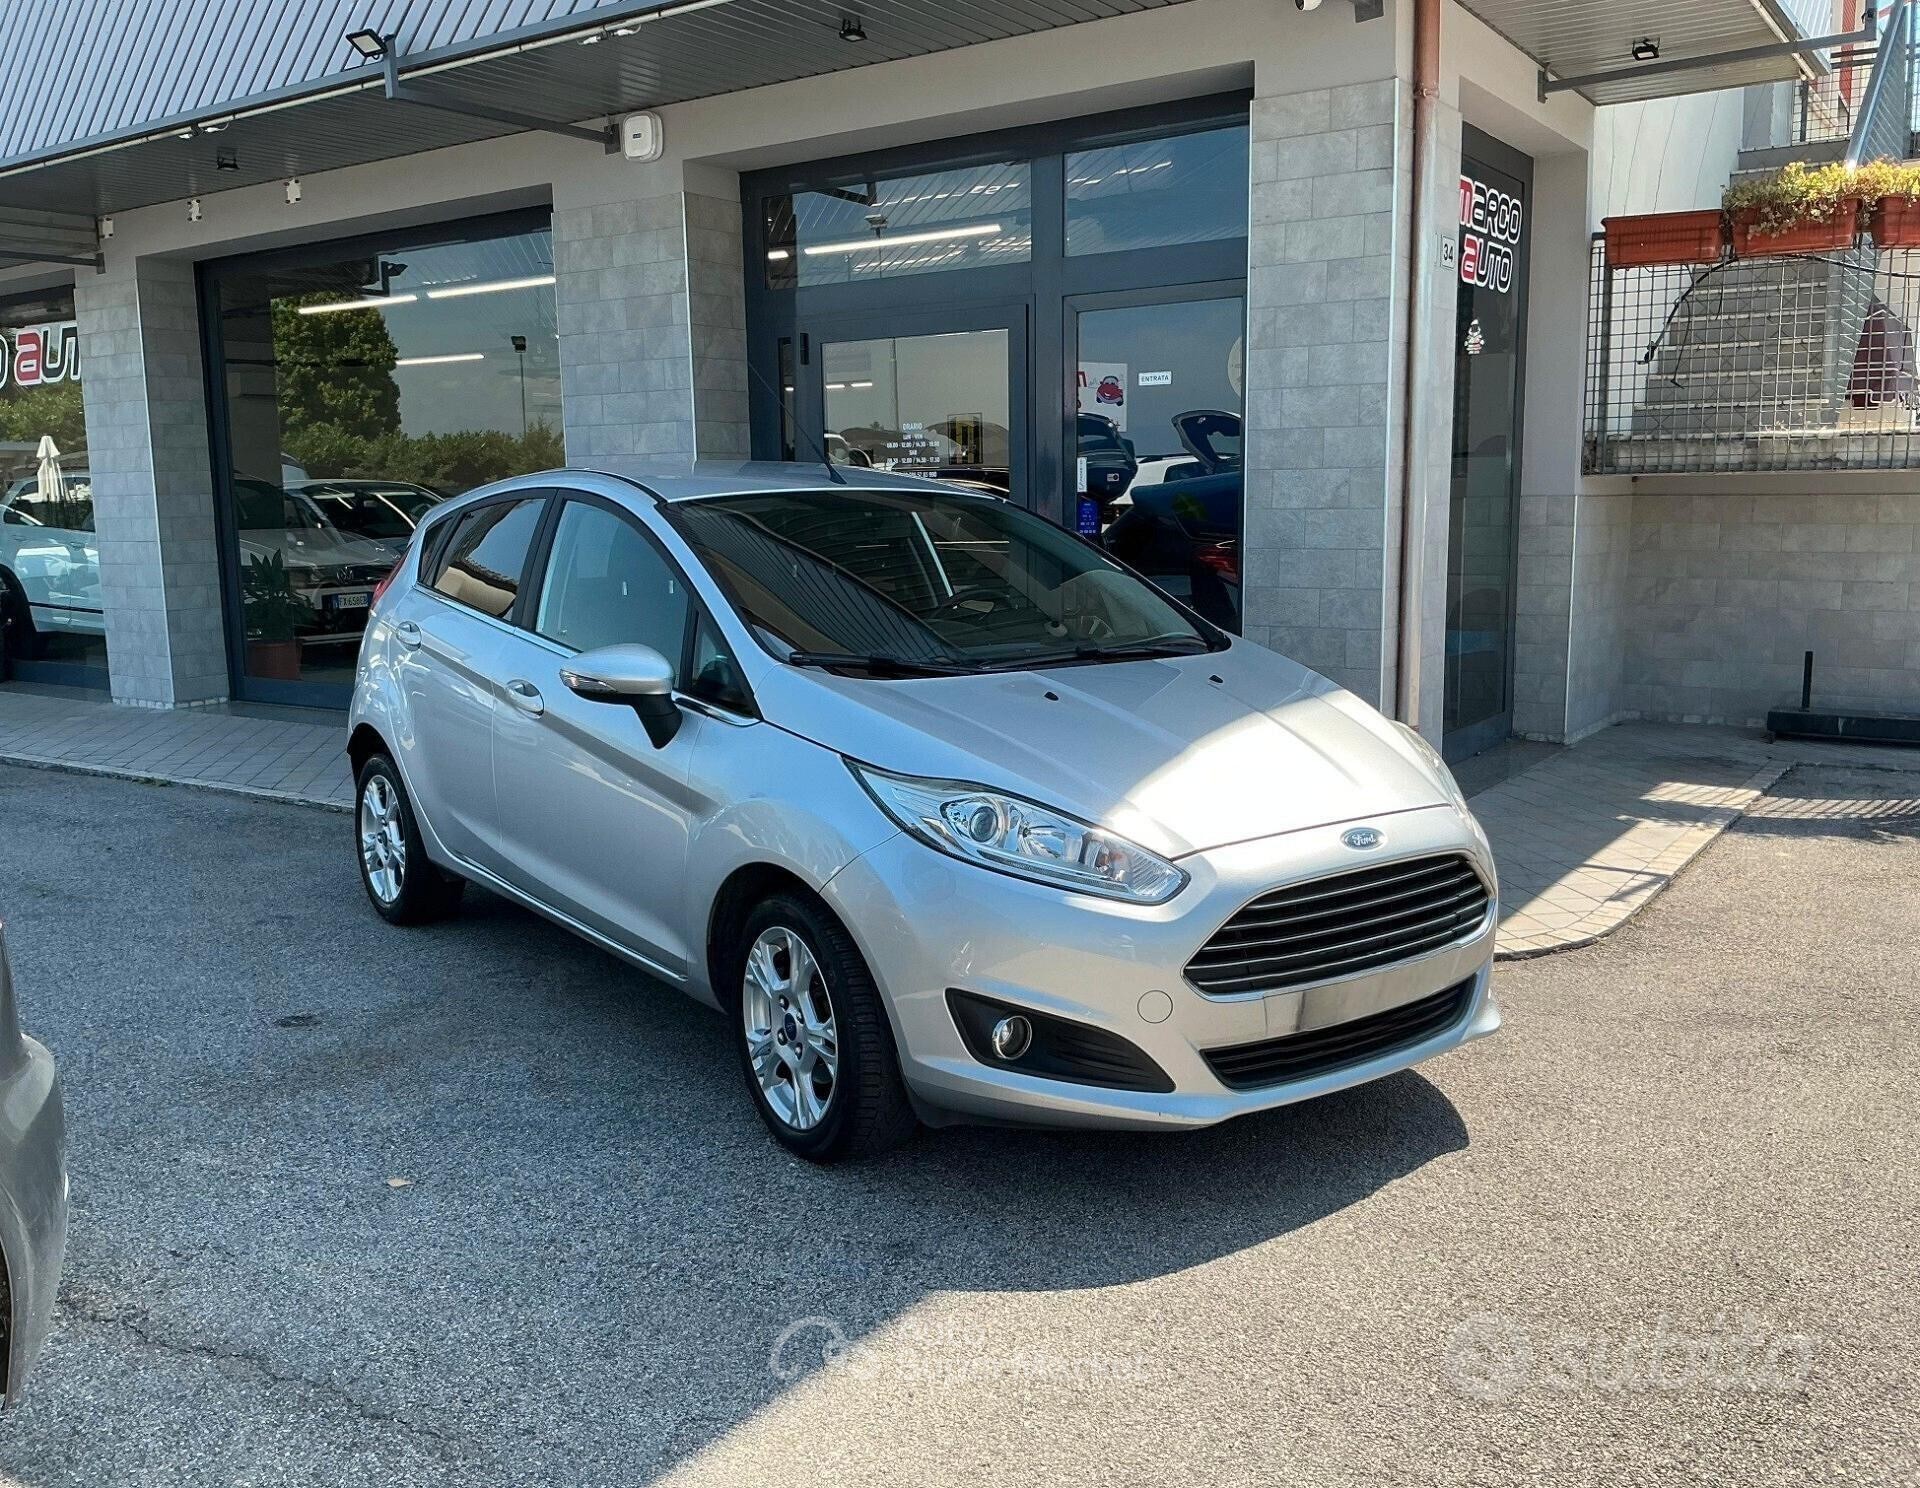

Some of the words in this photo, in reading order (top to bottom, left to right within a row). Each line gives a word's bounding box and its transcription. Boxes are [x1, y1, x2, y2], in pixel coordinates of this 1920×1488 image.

[1443, 243, 1454, 260] 34
[1141, 374, 1169, 383] ENTRATA
[1352, 833, 1377, 846] Ford
